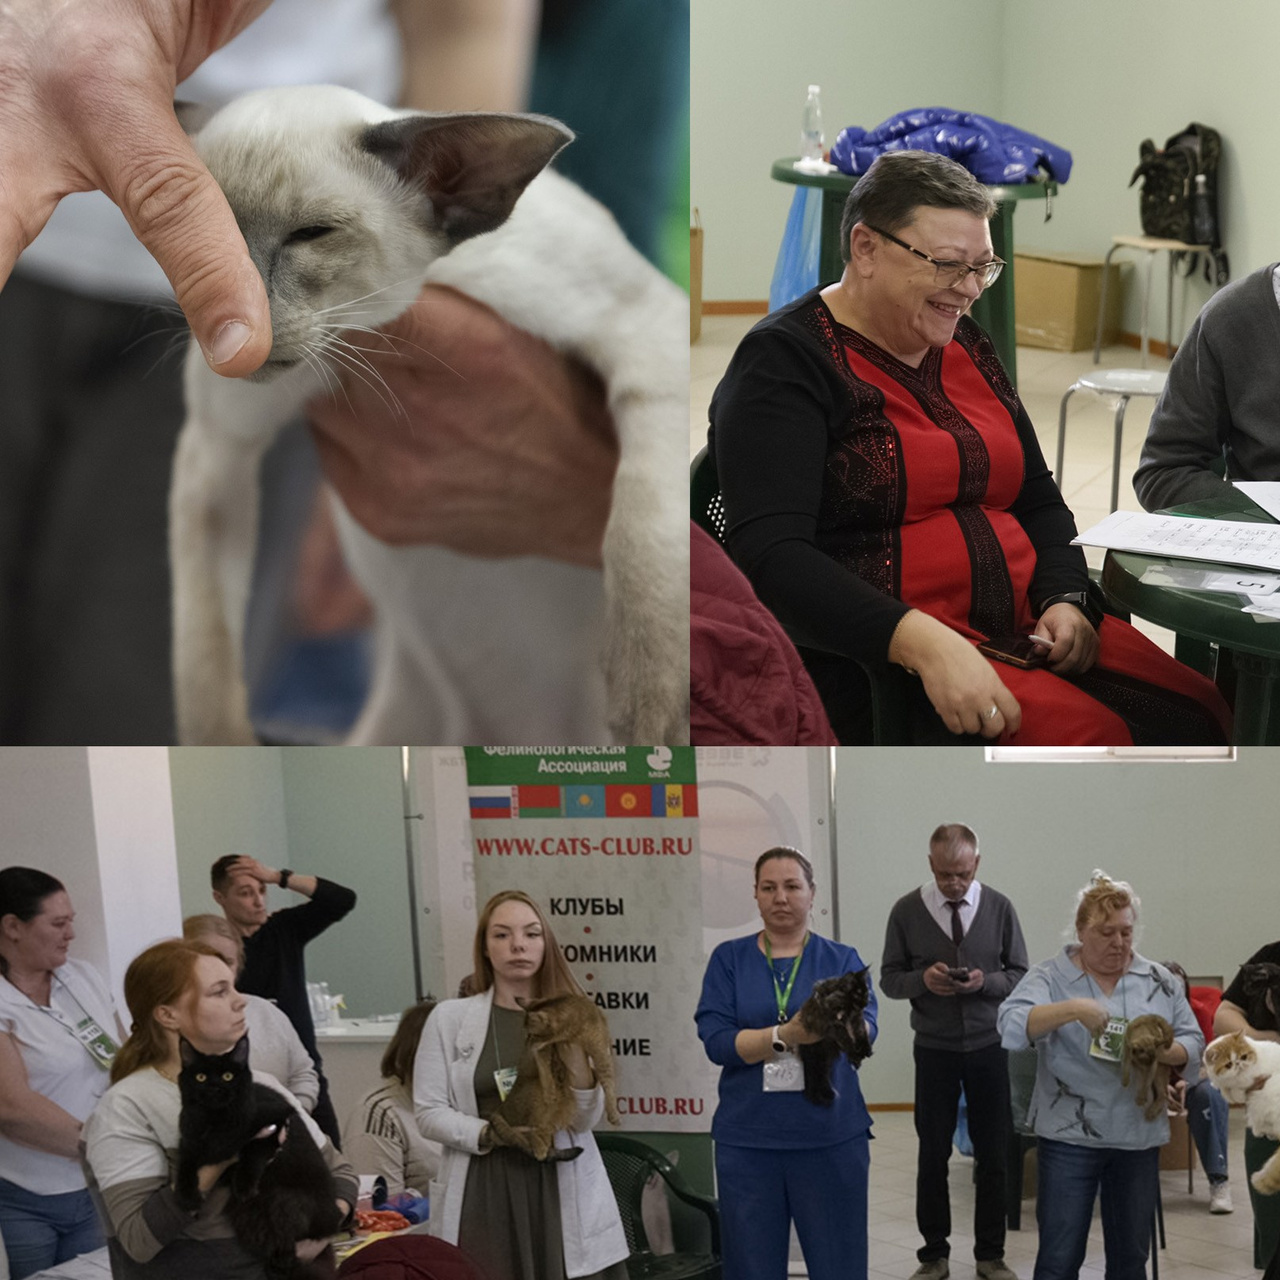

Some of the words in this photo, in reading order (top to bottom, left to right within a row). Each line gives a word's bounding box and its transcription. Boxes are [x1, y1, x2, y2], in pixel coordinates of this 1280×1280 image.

[537, 758, 627, 774] Ассоциация
[476, 837, 693, 856] WWW.CATS-CLUB.RU
[550, 898, 624, 916] КЛУБЫ
[562, 944, 657, 963] ОМНИКИ
[592, 991, 650, 1010] АВКИ
[616, 1096, 704, 1116] CLUB.RU
